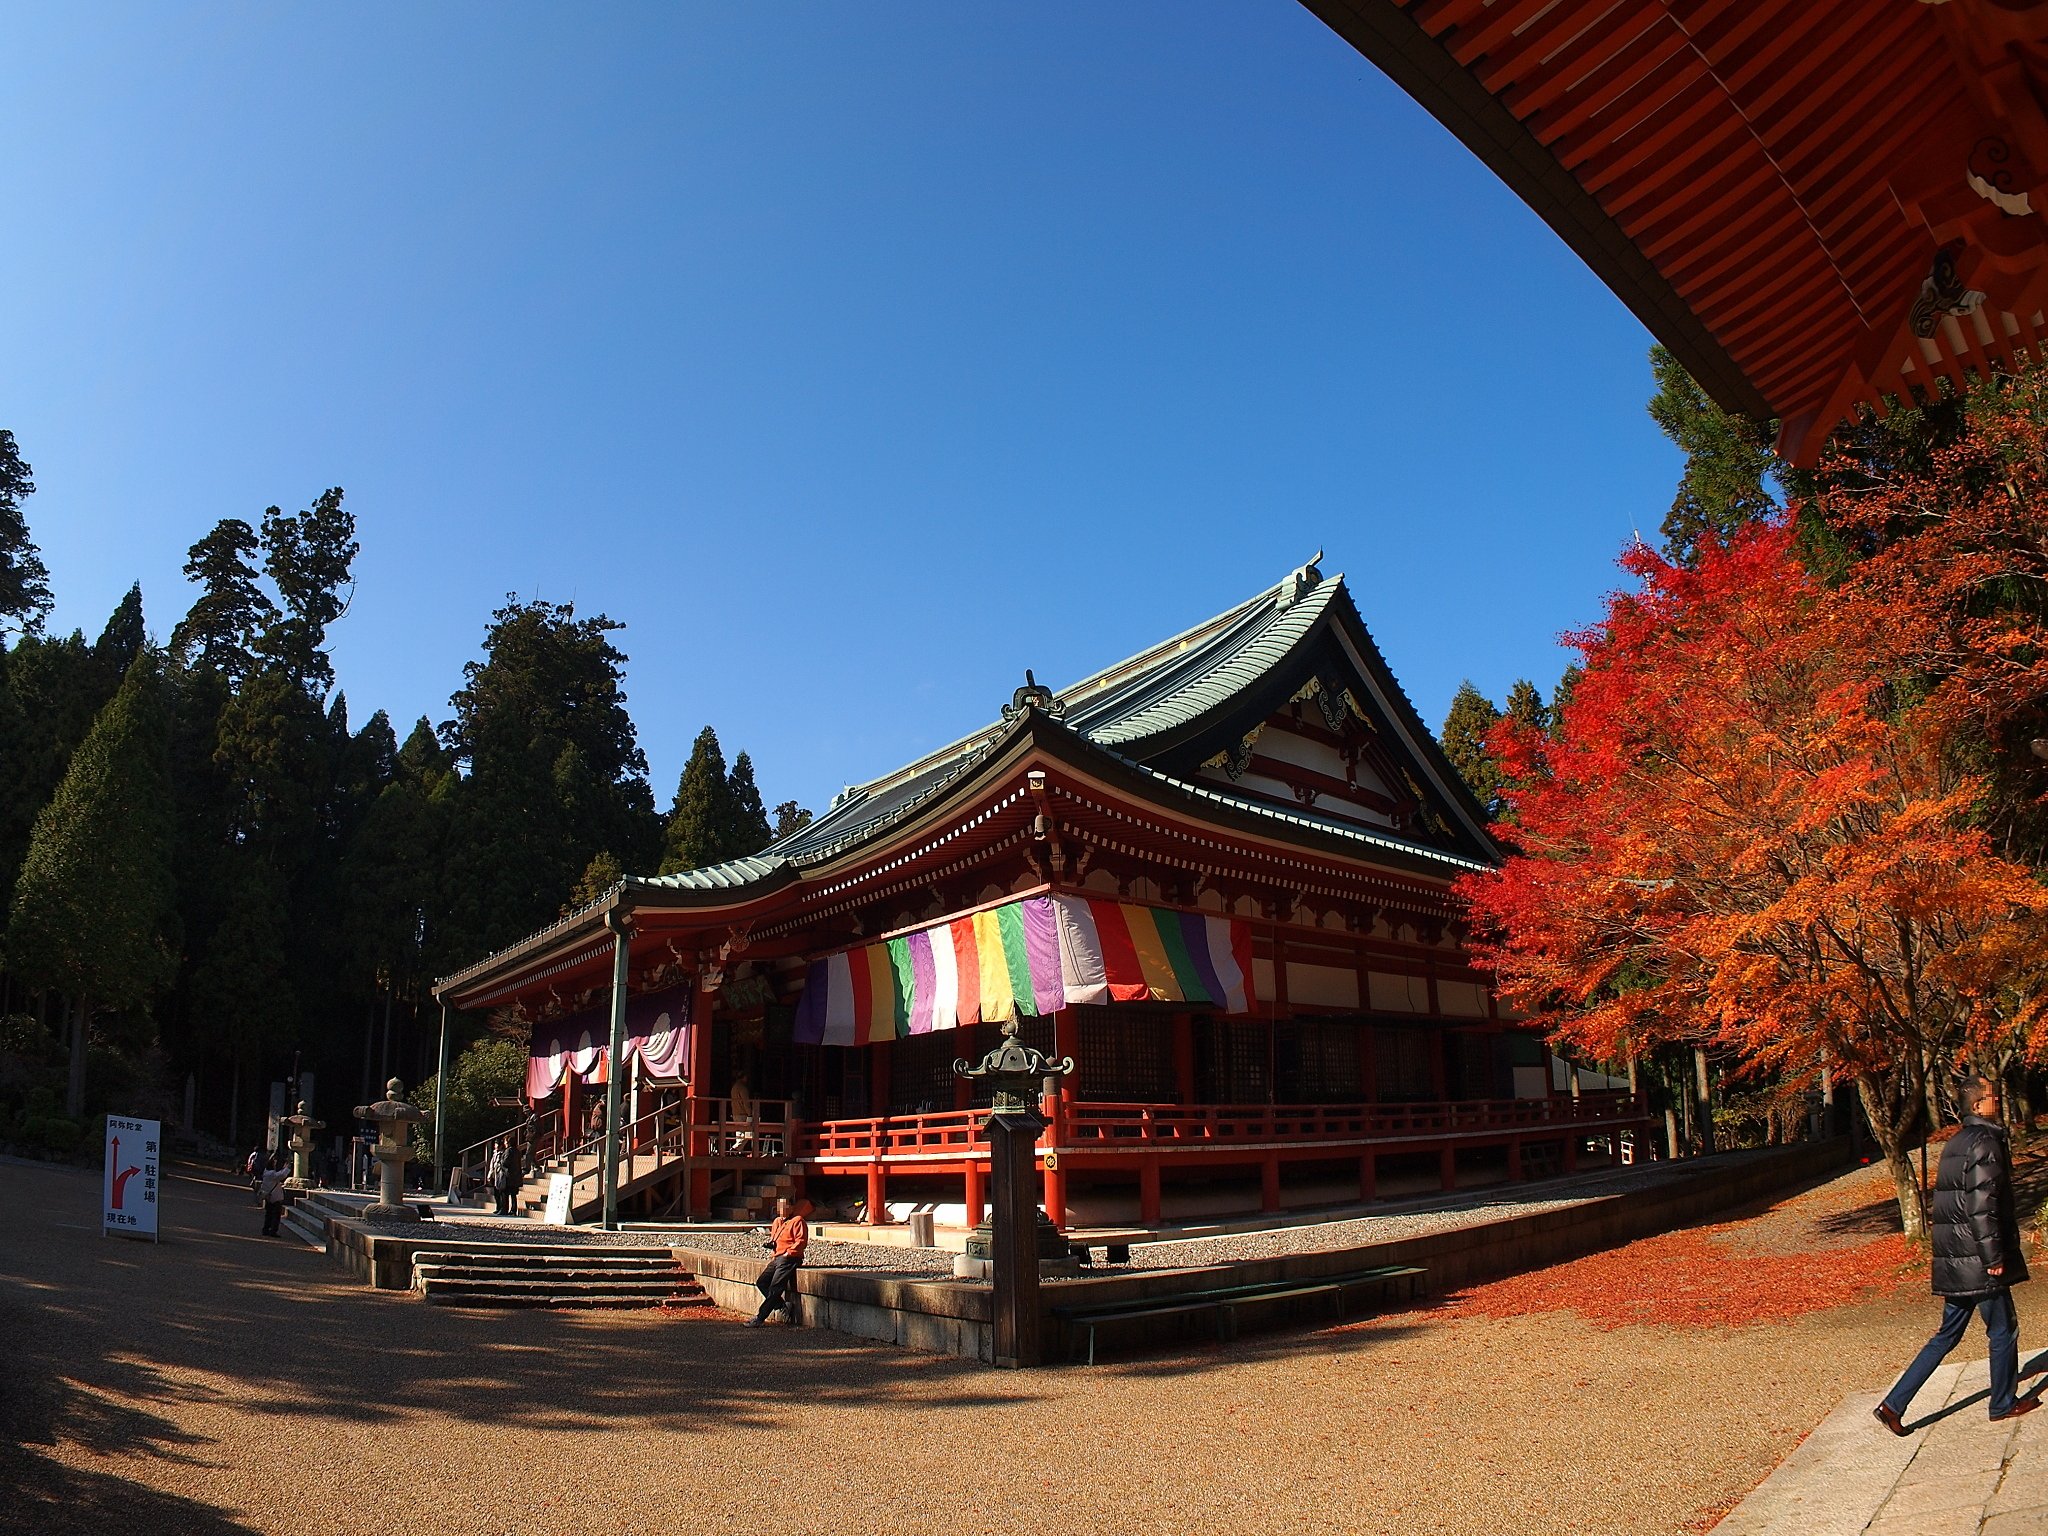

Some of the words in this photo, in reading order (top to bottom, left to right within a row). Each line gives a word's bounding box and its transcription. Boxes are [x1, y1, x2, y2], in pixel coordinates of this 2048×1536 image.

[144, 1140, 157, 1204] 第一駐車場
[106, 1212, 137, 1225] 現在地
